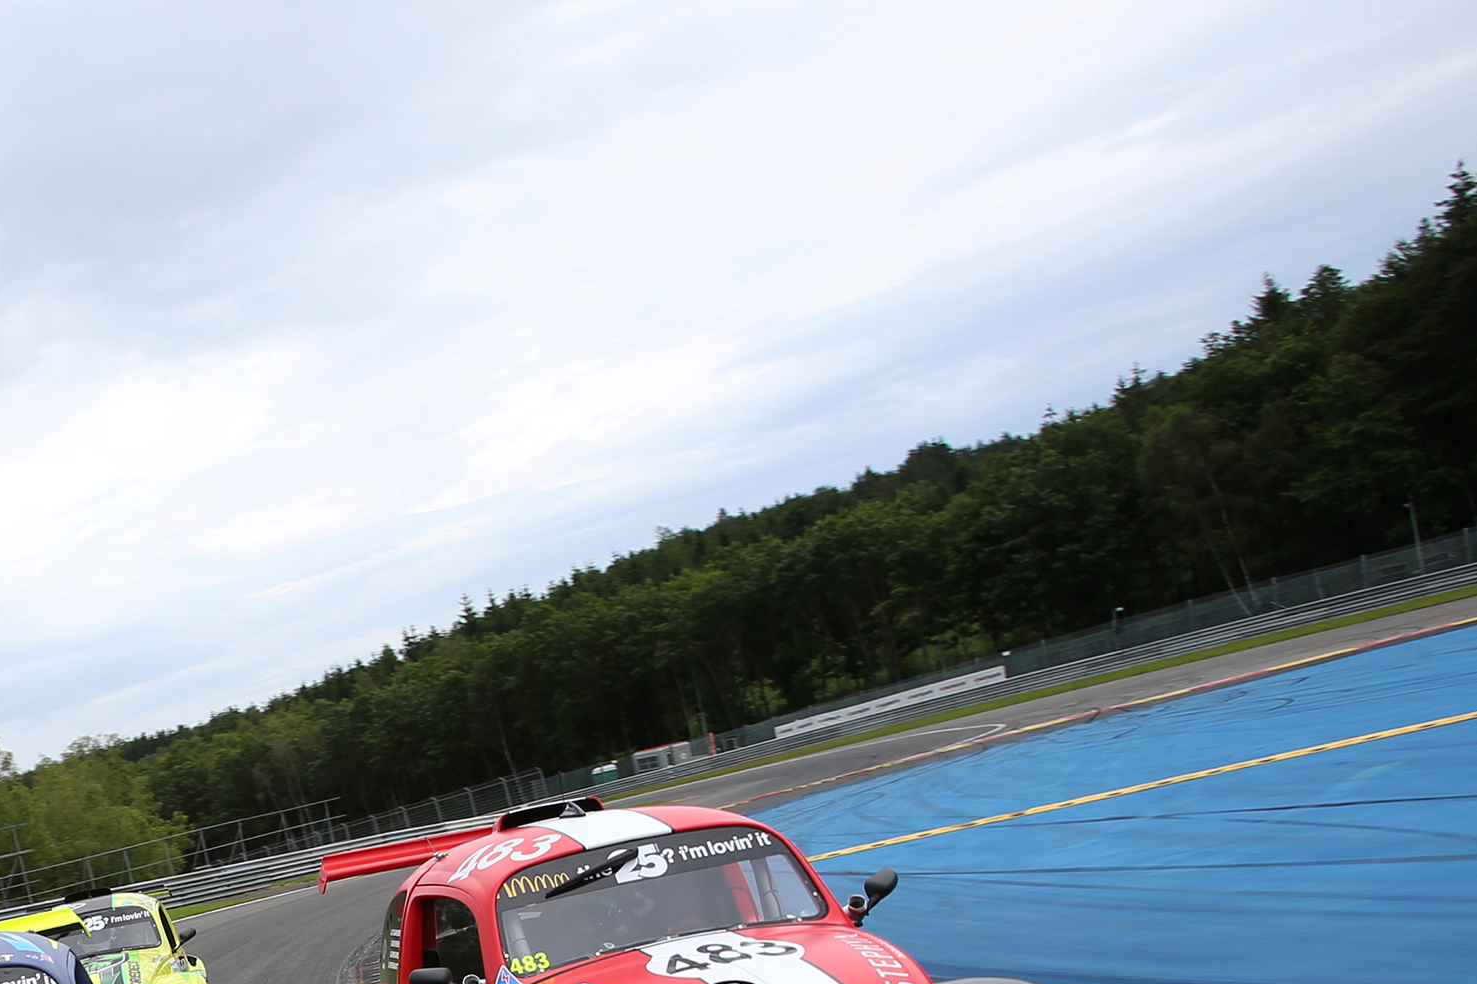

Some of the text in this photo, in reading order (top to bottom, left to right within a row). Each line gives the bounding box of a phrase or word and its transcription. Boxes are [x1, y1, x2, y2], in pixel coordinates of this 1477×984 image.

[447, 833, 562, 884] 483
[706, 833, 753, 858] lovin'
[752, 831, 772, 848] it
[510, 952, 550, 975] 483
[665, 941, 798, 976] 483
